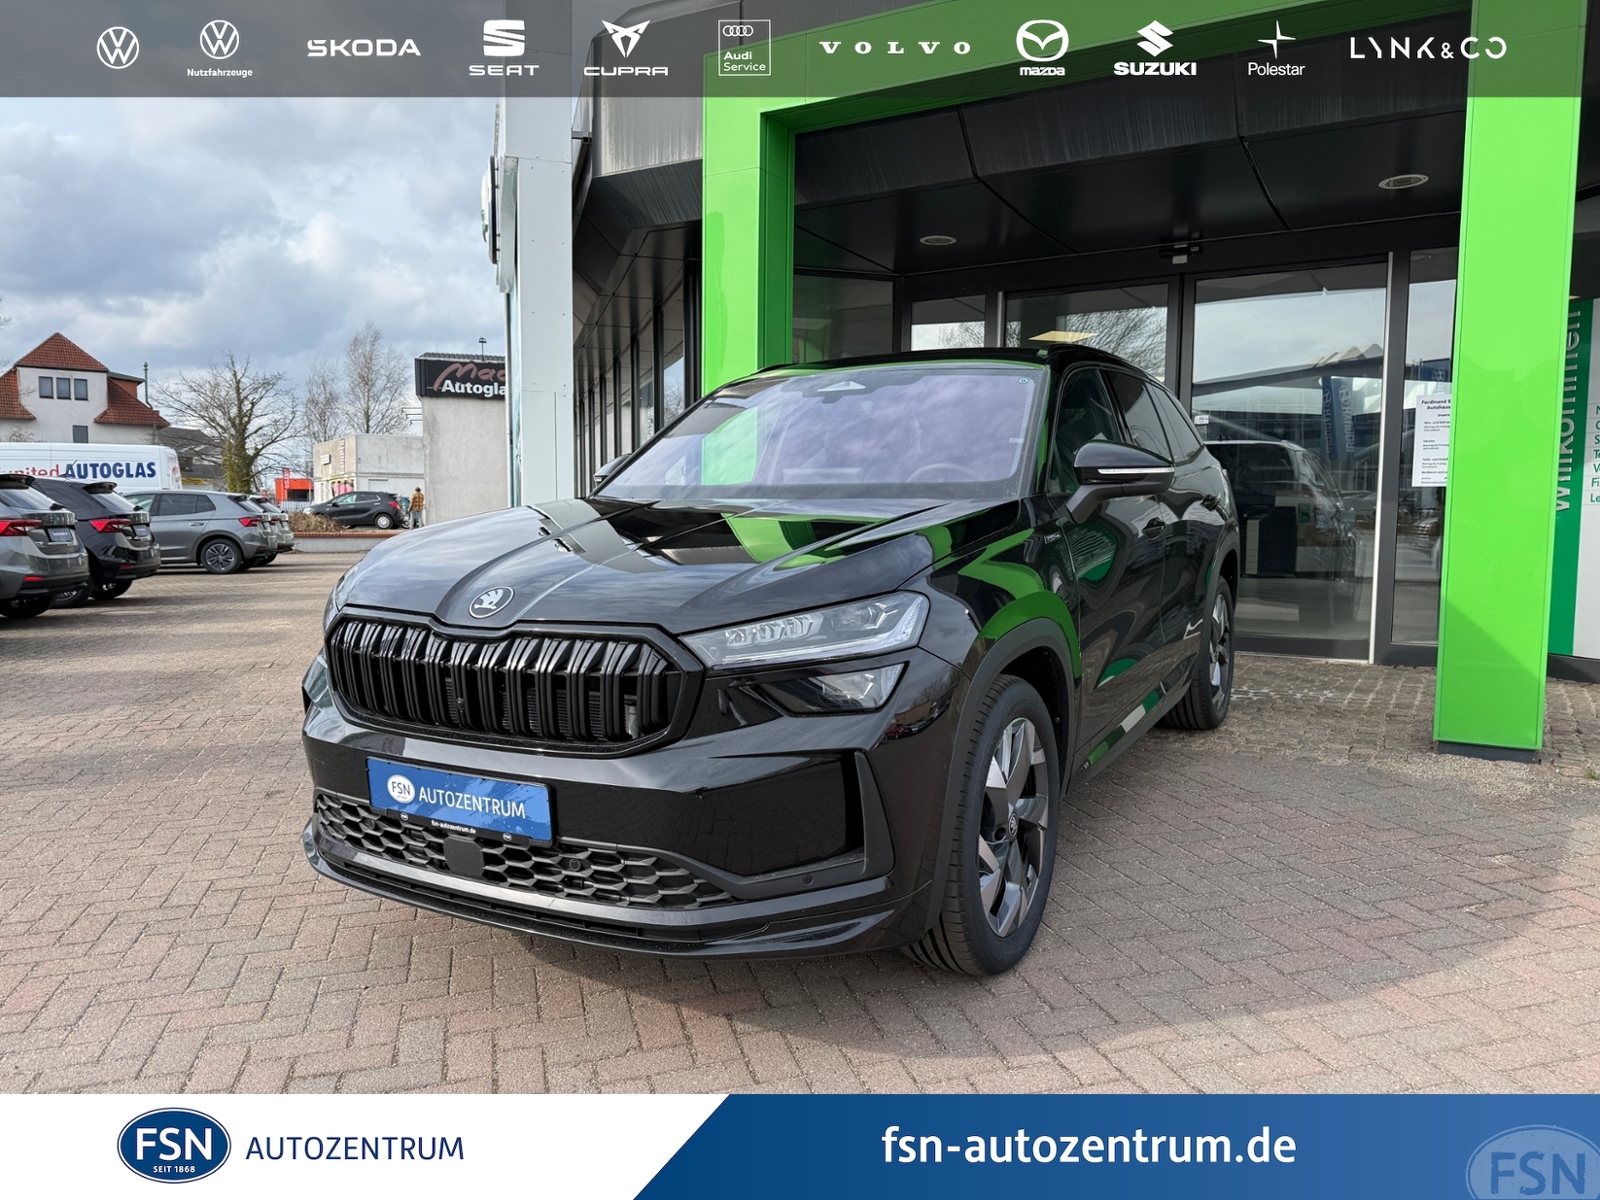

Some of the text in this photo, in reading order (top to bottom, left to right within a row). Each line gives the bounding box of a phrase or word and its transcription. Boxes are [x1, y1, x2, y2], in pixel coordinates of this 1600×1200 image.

[66, 462, 156, 479] AUTOGLAS
[391, 781, 526, 819] FSN AUTOZENTRUM
